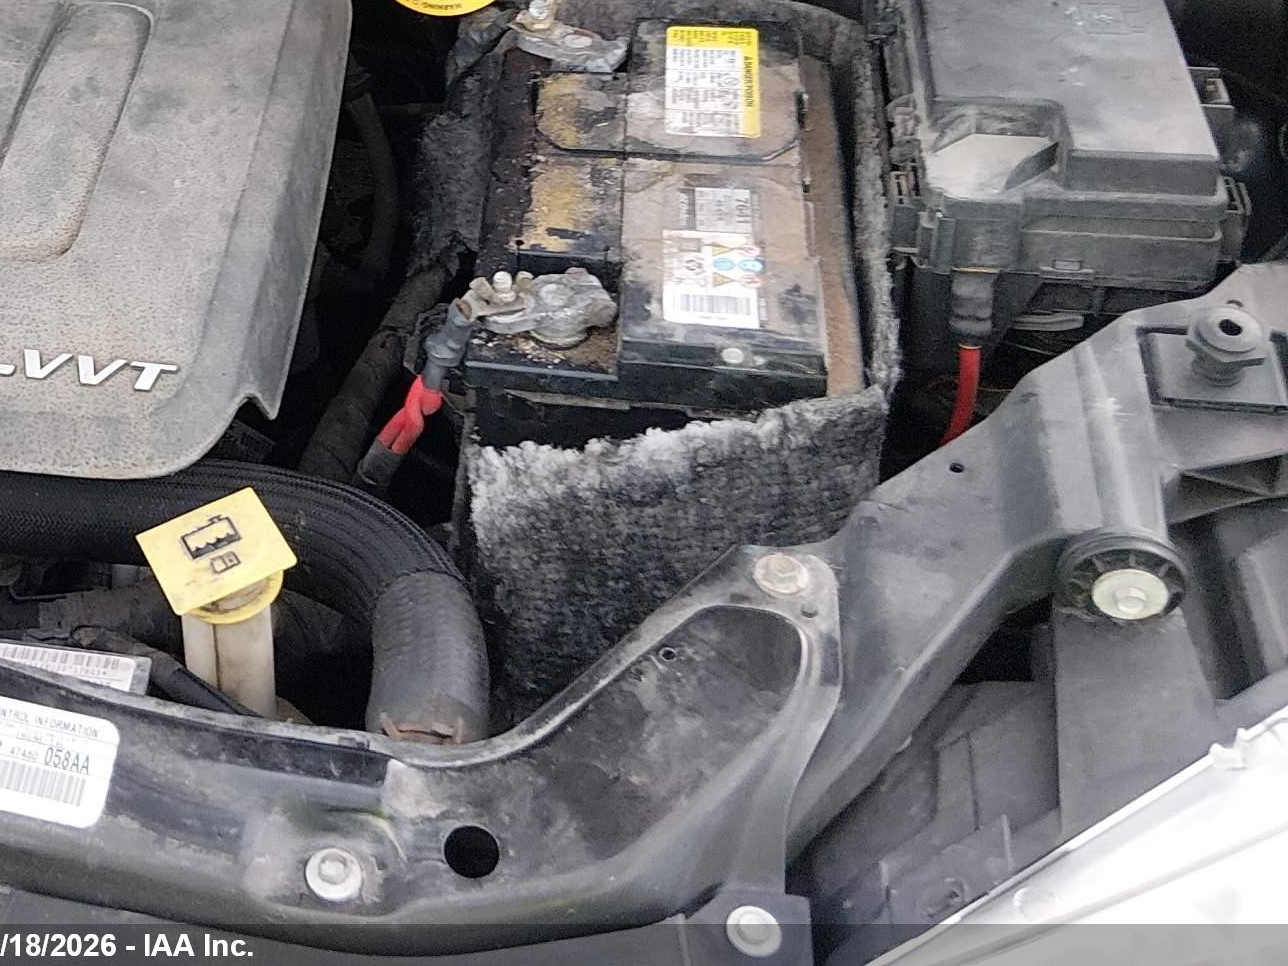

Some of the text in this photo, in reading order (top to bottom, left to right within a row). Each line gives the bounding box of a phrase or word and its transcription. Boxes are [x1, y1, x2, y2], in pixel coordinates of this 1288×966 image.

[23, 348, 179, 392] VVT
[34, 715, 100, 738] INFORMATION
[44, 746, 90, 775] 058AA
